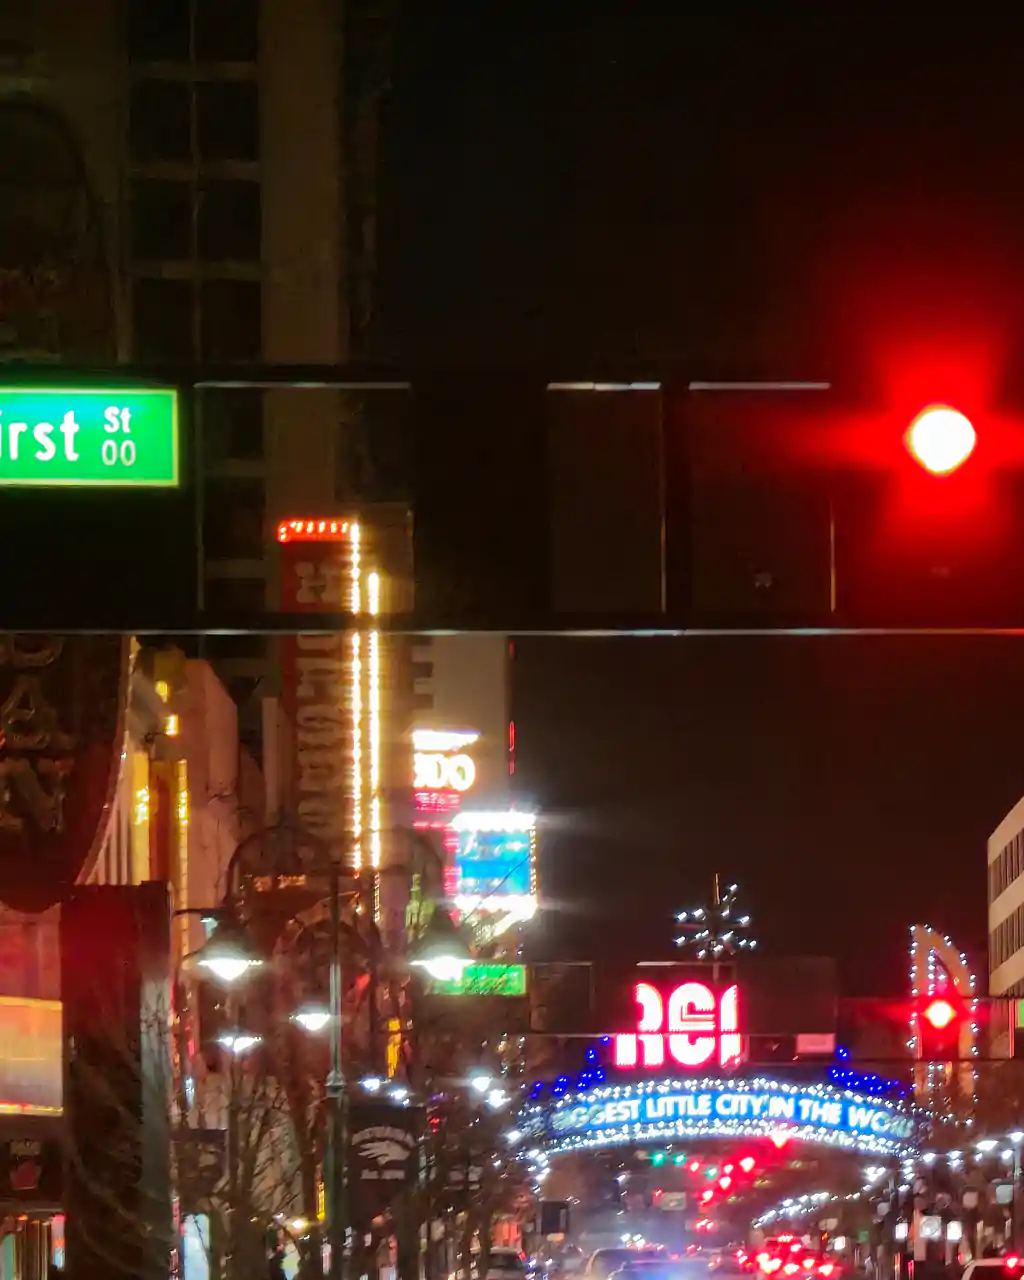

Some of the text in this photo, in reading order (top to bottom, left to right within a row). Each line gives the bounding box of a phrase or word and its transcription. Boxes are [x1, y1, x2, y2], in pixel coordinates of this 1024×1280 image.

[0, 406, 131, 462] rst St
[101, 440, 136, 467] 00
[616, 982, 742, 1066] RE
[646, 1094, 712, 1119] LITTLE
[715, 1093, 768, 1117] CITY
[769, 1095, 795, 1119] IN
[799, 1098, 843, 1125] THE
